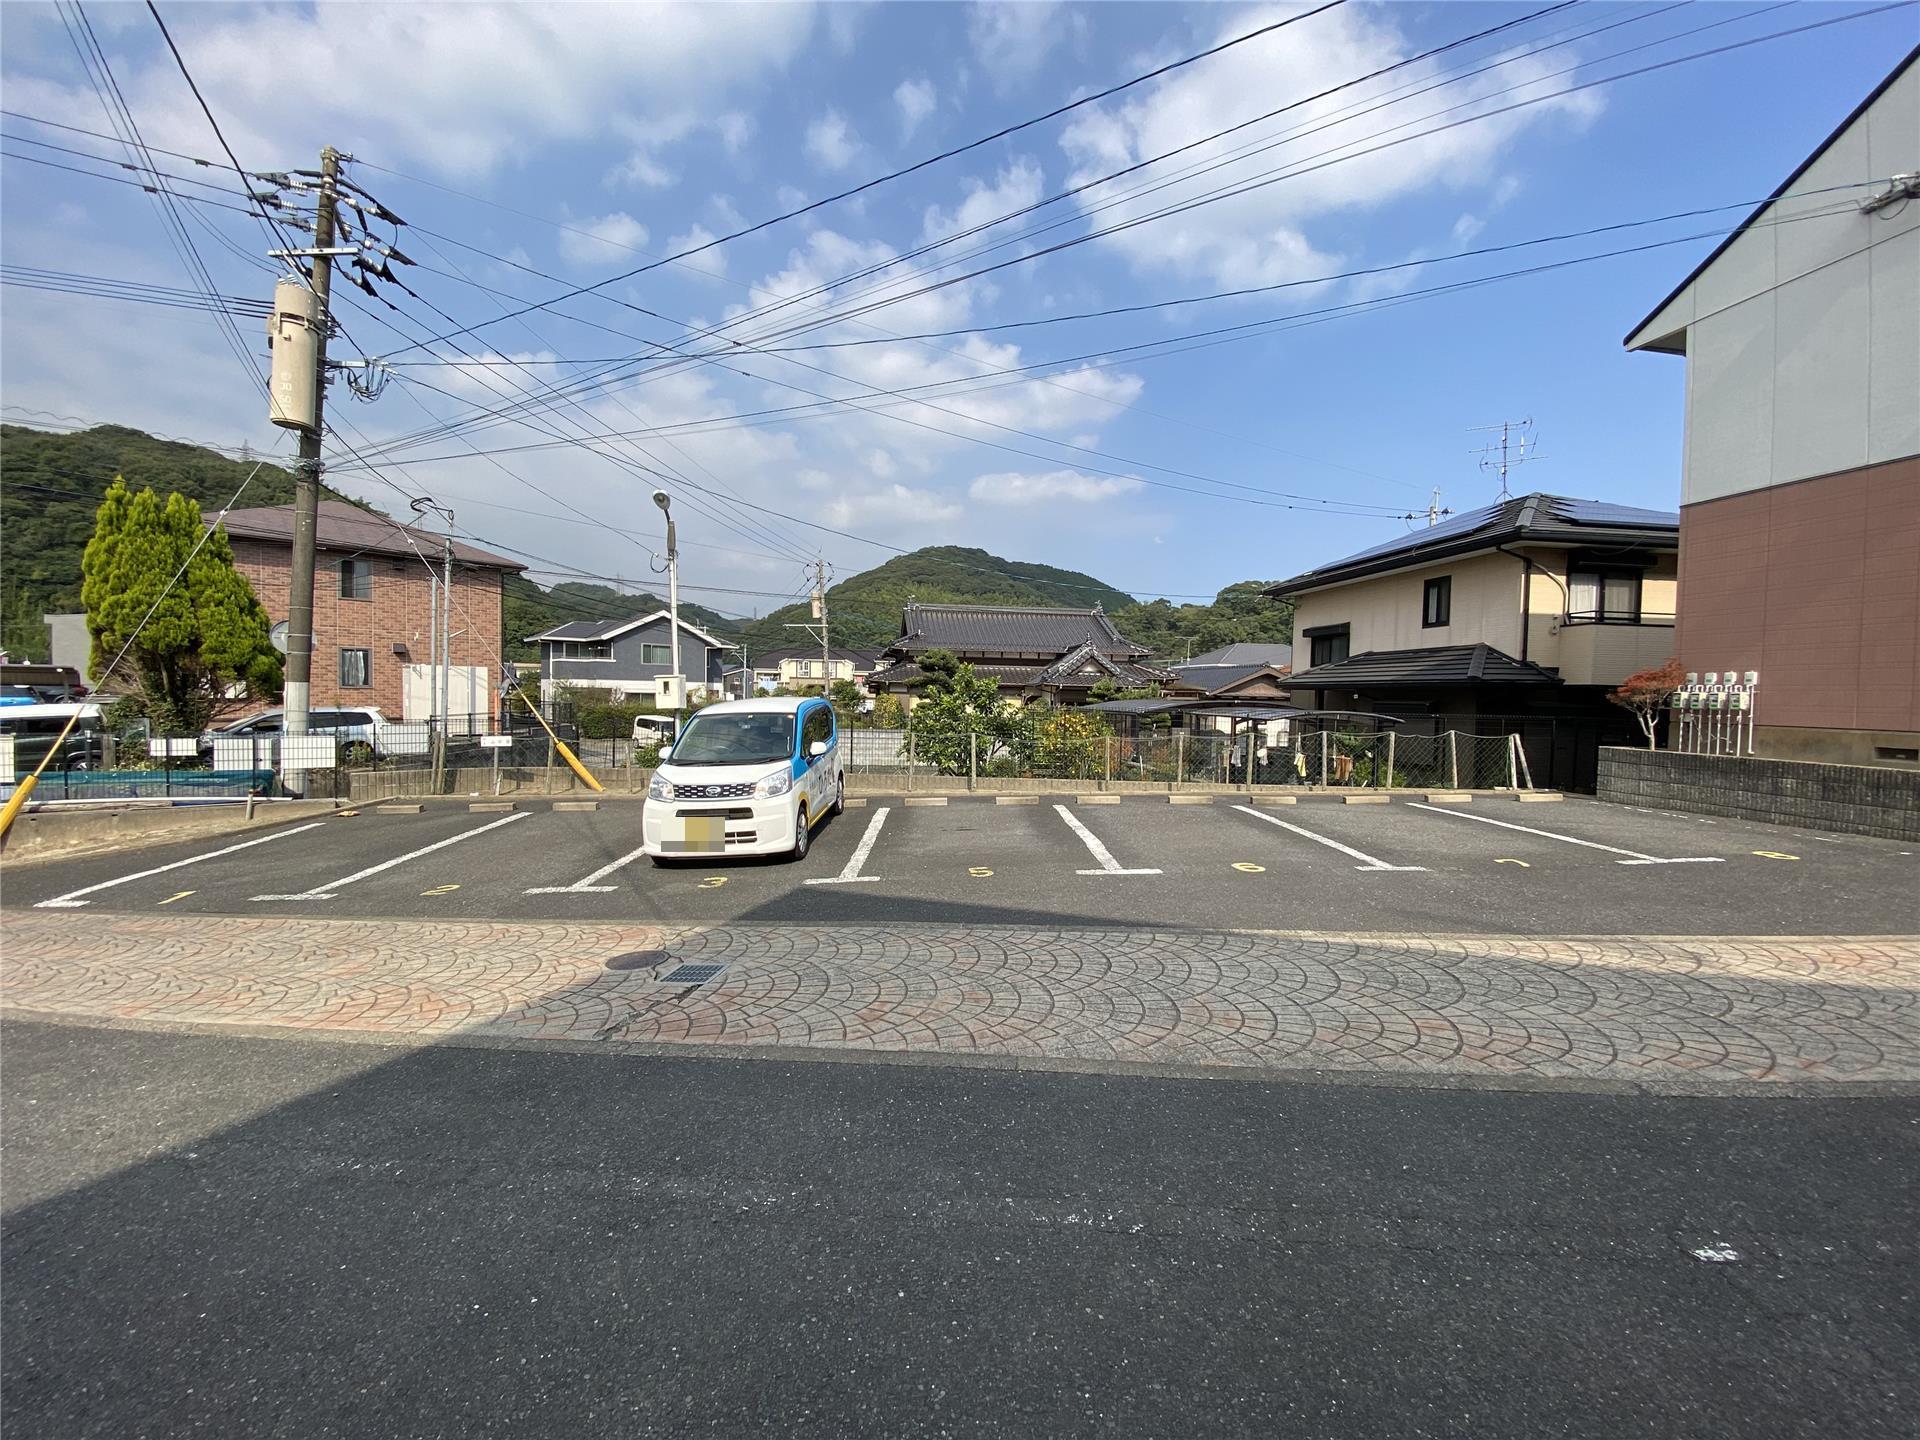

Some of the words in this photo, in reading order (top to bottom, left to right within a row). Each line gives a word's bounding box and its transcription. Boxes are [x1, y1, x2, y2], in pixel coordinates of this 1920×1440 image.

[1752, 851, 1800, 860] 8
[1231, 862, 1266, 872] 6
[1494, 858, 1530, 867] 7
[968, 866, 994, 877] 5
[697, 877, 728, 888] 3
[420, 884, 461, 896] 2
[157, 890, 198, 905] 1
